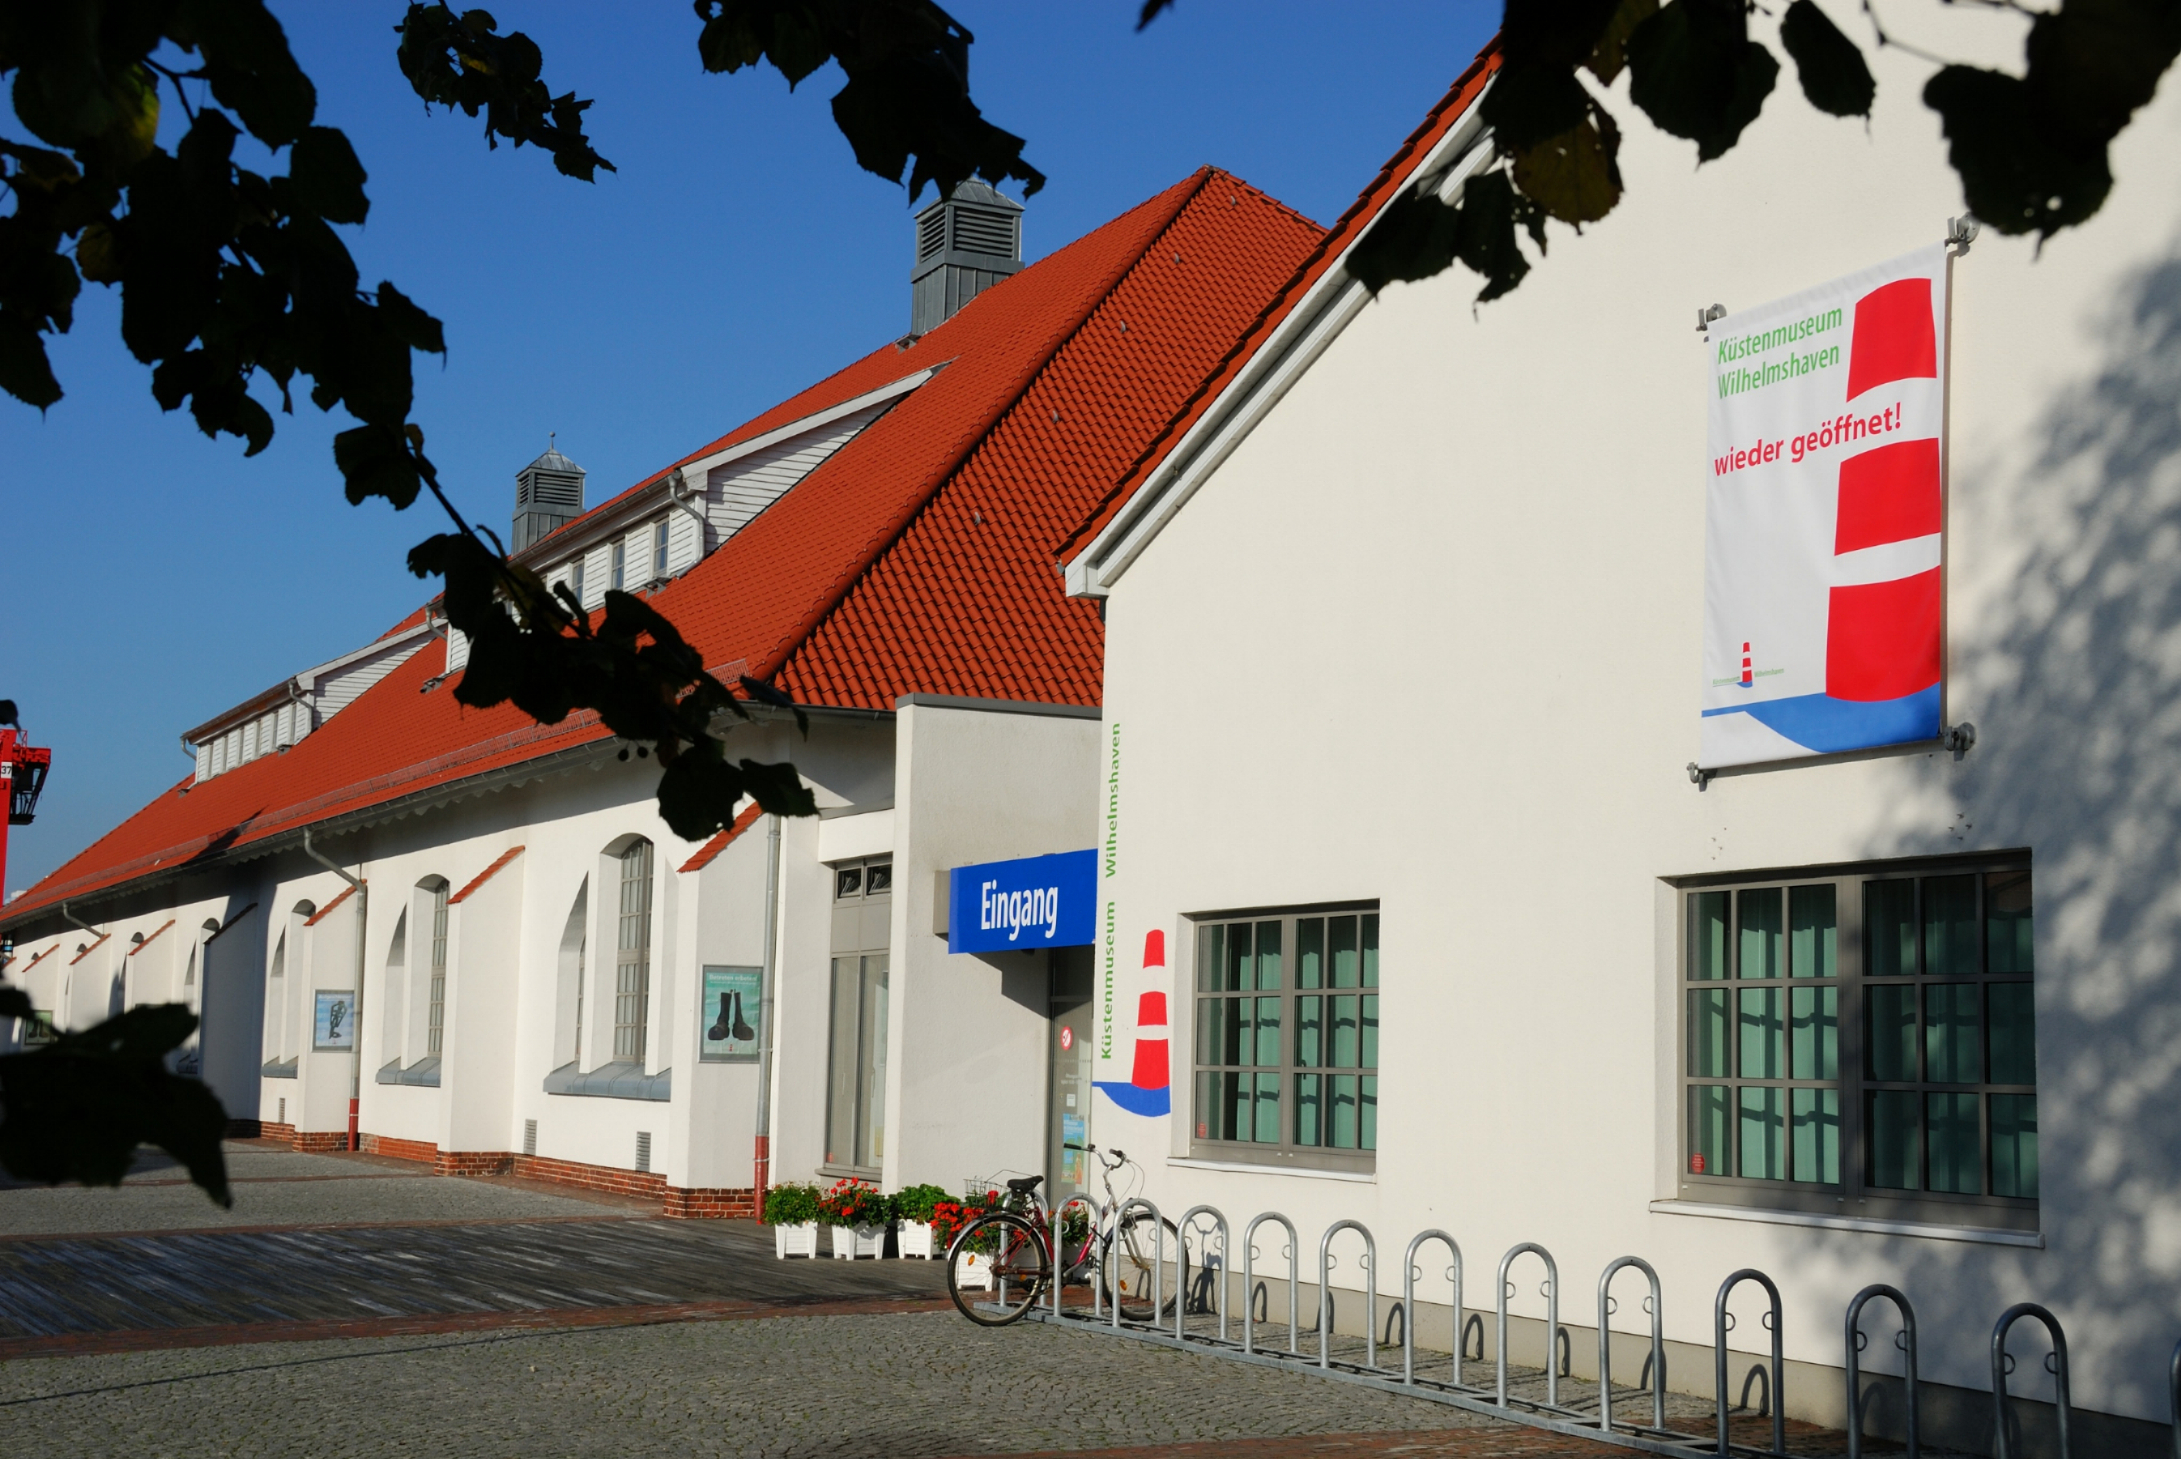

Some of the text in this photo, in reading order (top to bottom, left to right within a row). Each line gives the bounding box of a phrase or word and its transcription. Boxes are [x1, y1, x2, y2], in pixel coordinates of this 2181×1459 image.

[1717, 307, 1842, 365] Küstenmuseum
[1717, 345, 1840, 399] Wilhelmshaven
[1714, 402, 1901, 476] wieder geöffnet!
[980, 879, 1059, 941] Eingang
[1101, 723, 1121, 1060] Küstenmuseum Wilhelmshaven
